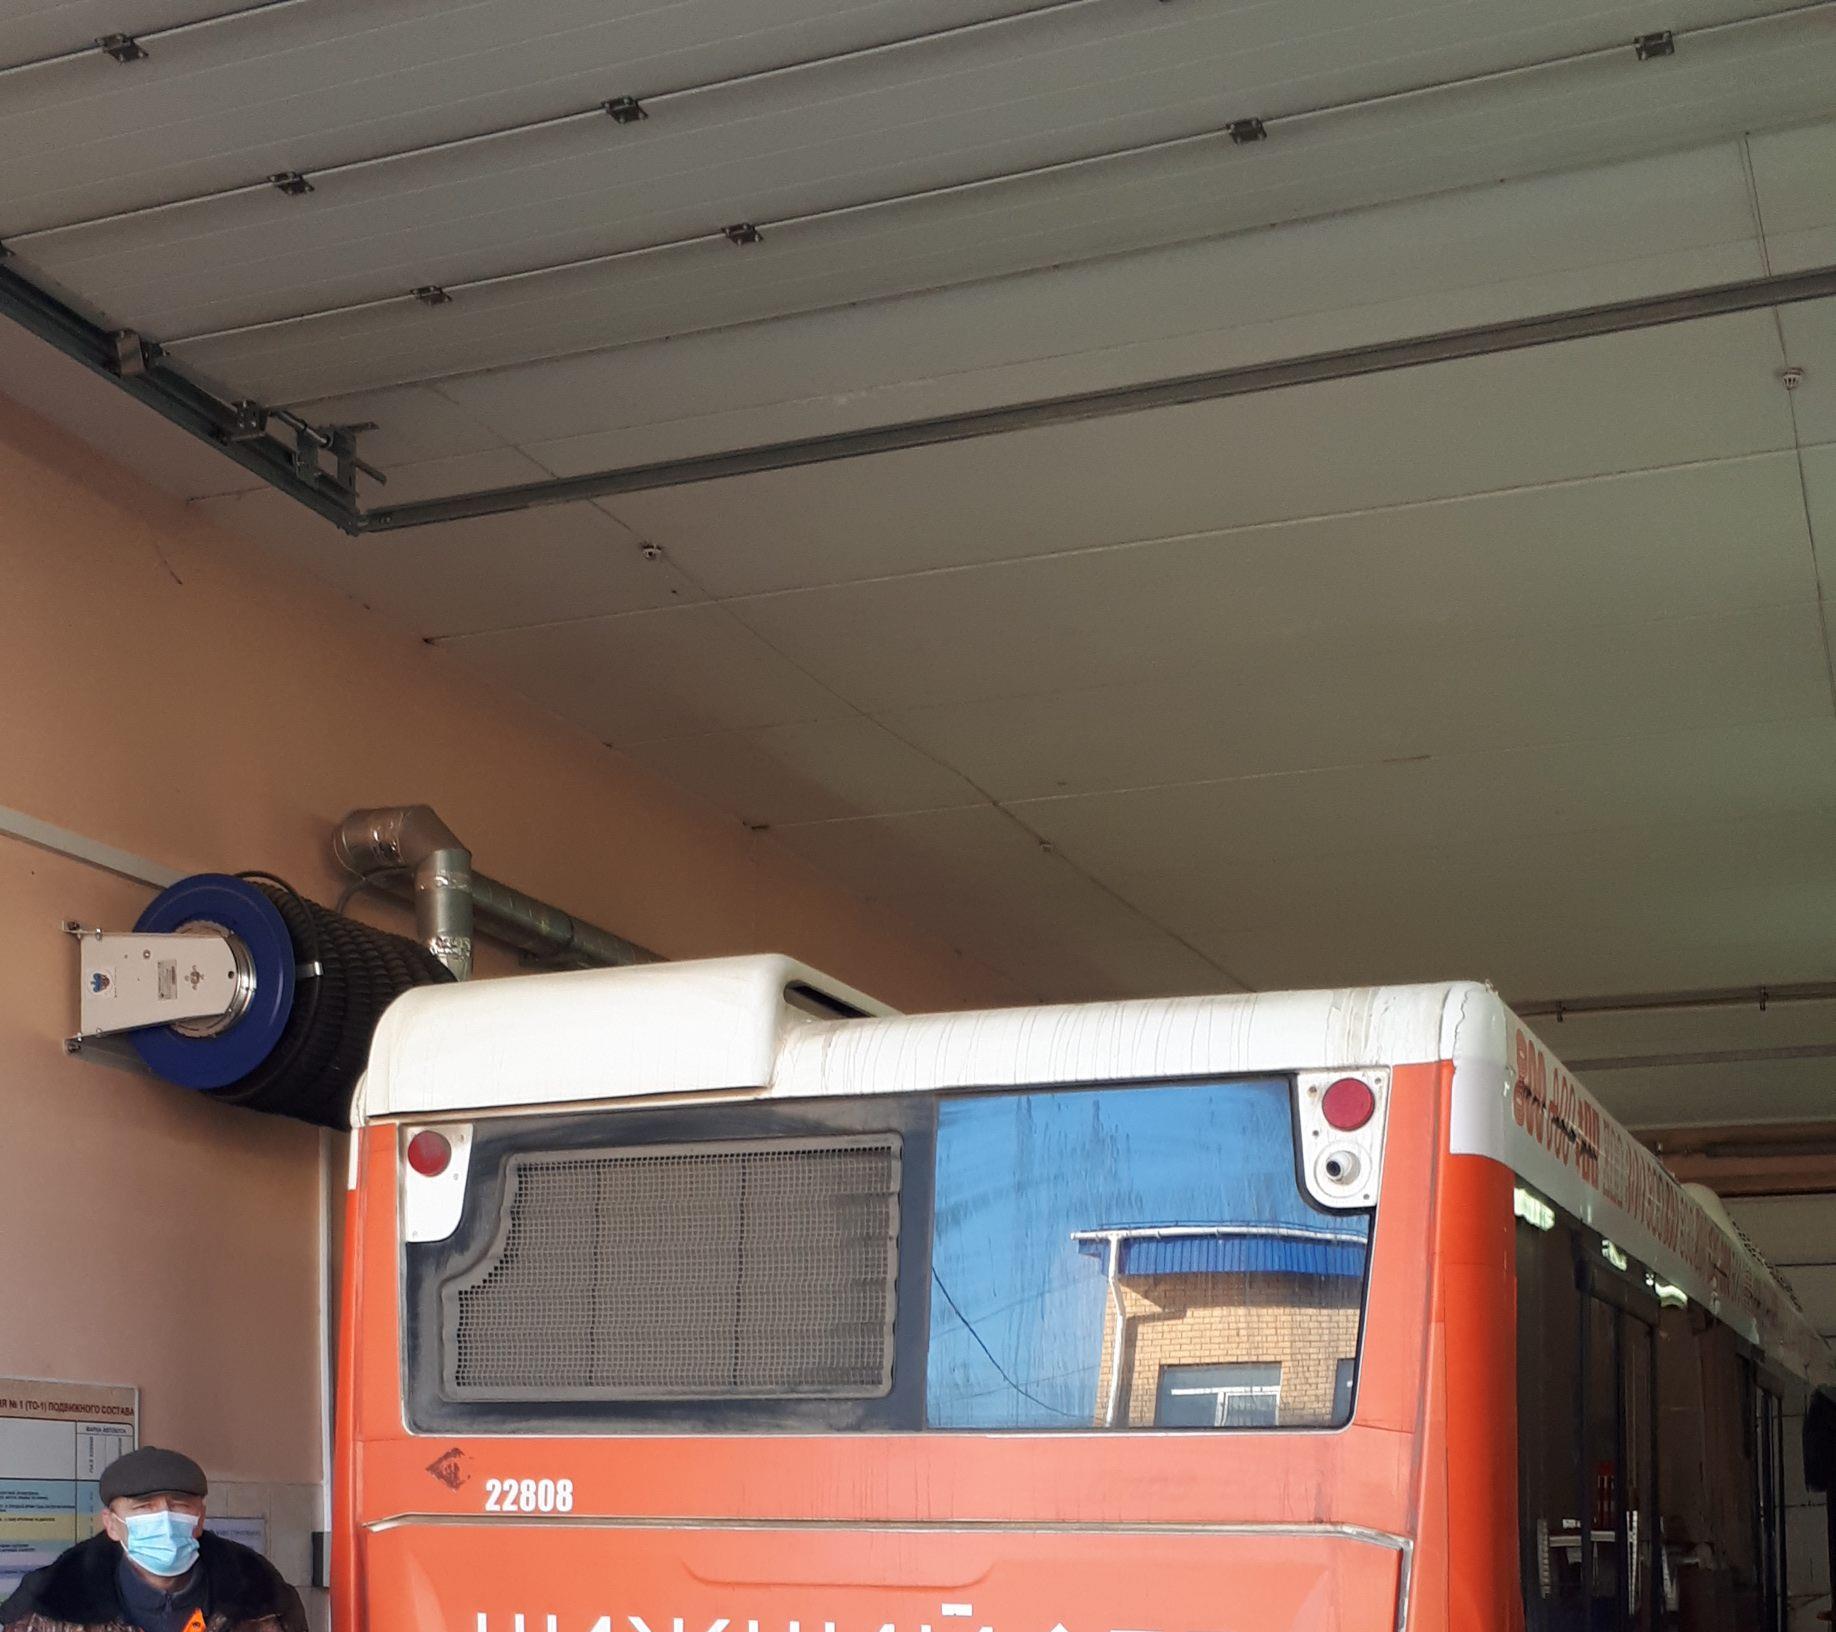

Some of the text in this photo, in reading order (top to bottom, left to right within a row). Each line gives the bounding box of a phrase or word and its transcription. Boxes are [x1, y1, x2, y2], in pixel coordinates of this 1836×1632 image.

[48, 1402, 100, 1414] ПОДВИЖНОГО
[101, 1405, 134, 1416] СОСТАВА
[485, 1478, 573, 1512] 22808
